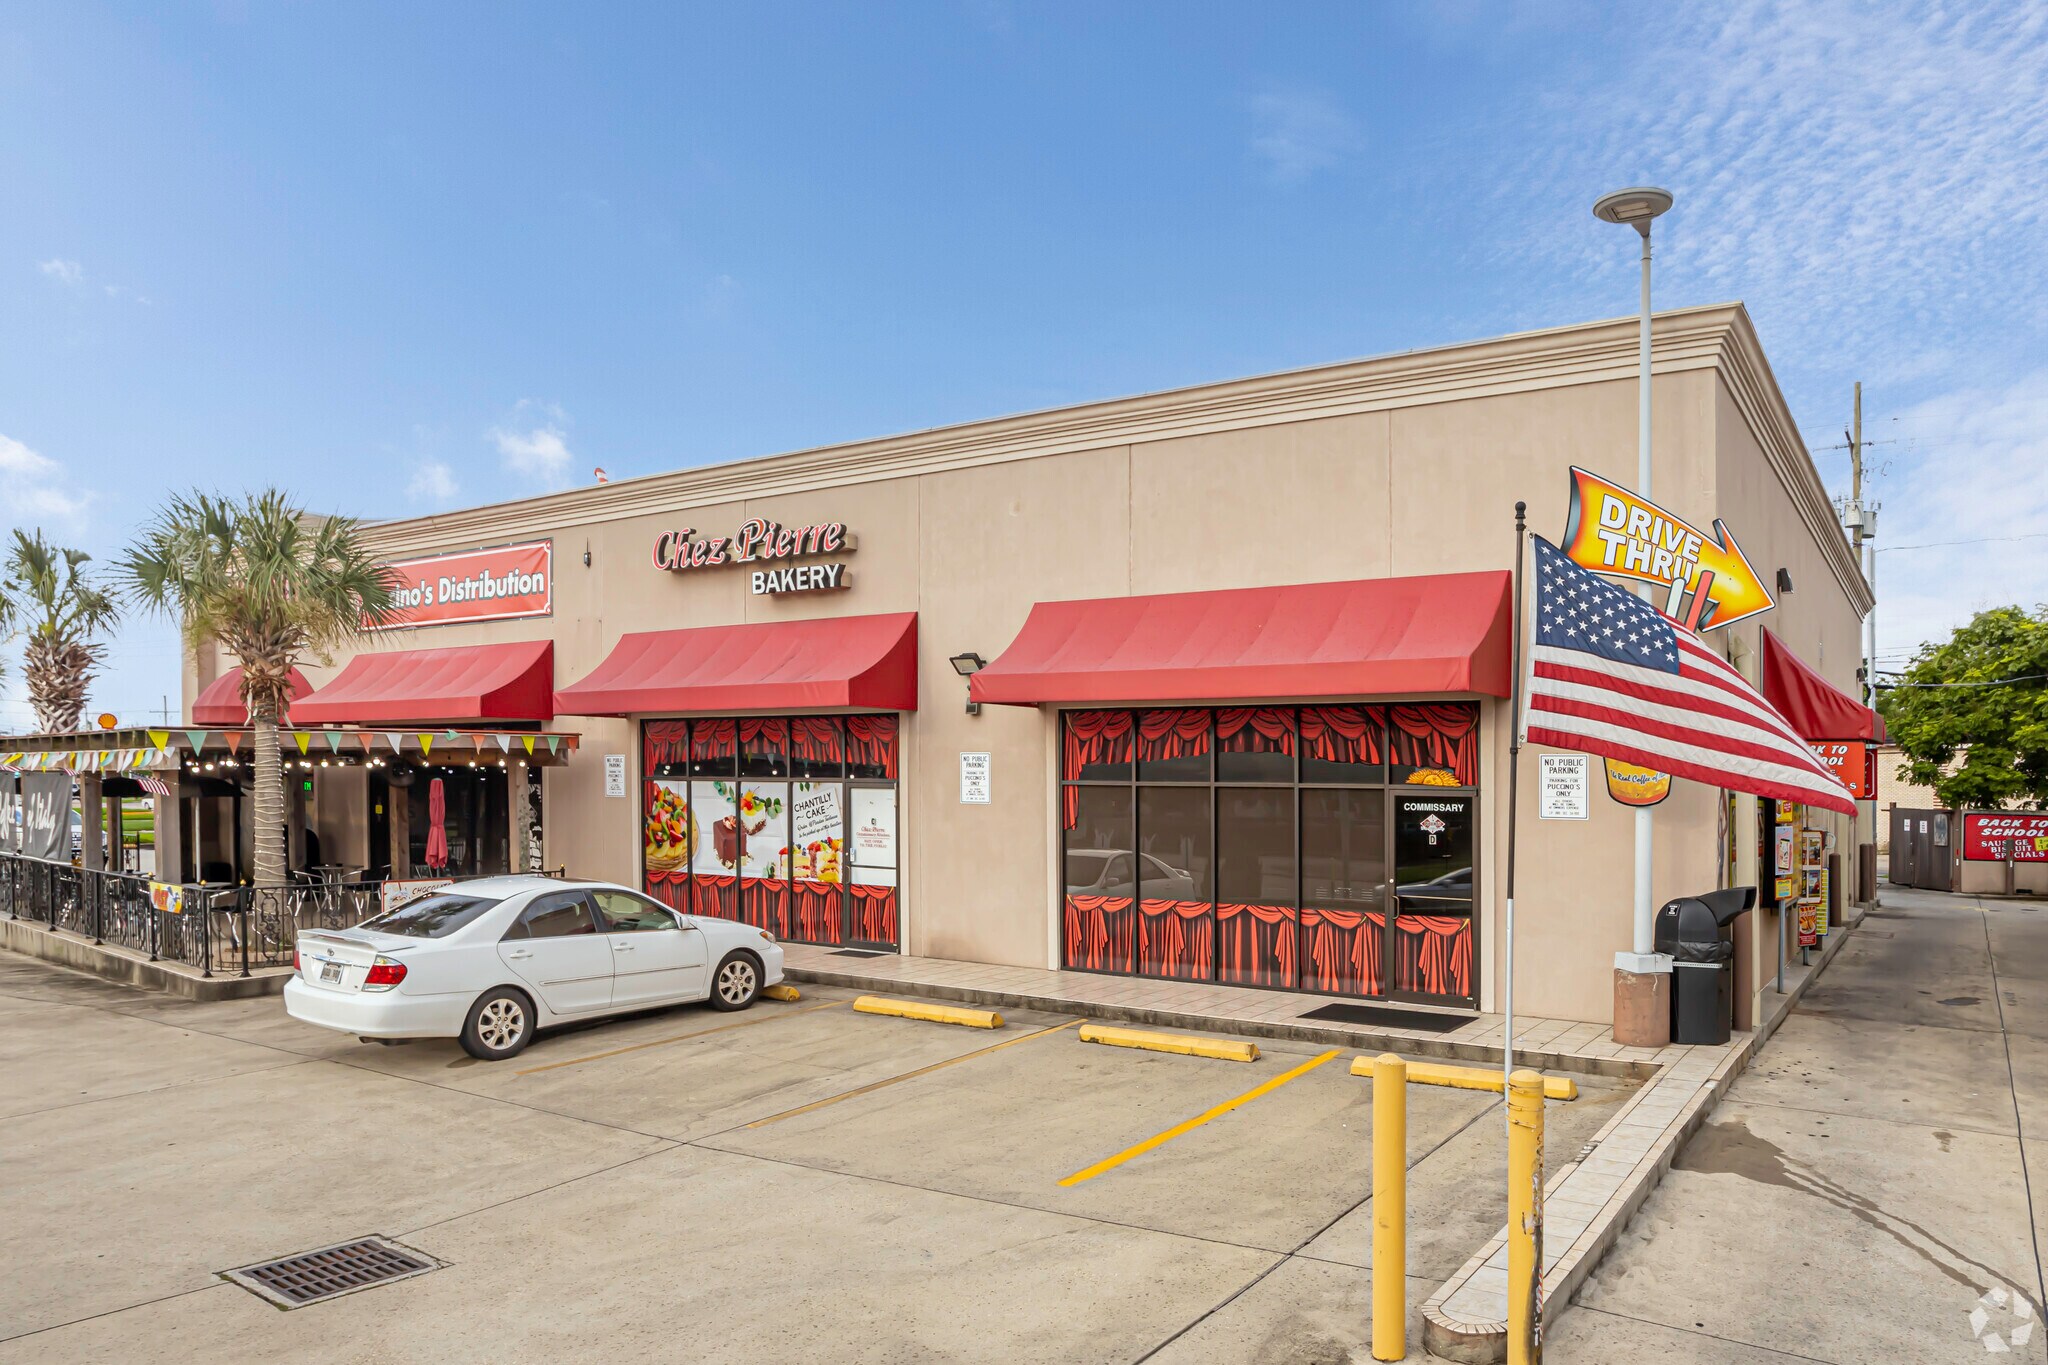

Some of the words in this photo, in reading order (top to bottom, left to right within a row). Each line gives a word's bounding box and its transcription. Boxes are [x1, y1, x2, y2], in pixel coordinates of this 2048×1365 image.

[1600, 494, 1703, 563] DRIVE
[652, 527, 727, 570] Chez
[734, 517, 842, 563] Pierre
[1598, 529, 1694, 585] THRU
[752, 564, 840, 594] BAKERY
[438, 568, 545, 605] Distribution
[1832, 745, 1848, 754] TO
[1632, 774, 1650, 784] Coffee
[794, 792, 832, 812] CHANTILLY
[1404, 802, 1464, 812] COMMISSARY
[806, 805, 826, 819] CAKE
[1978, 818, 2023, 827] BACK
[2030, 820, 2048, 828] TO
[1981, 828, 2045, 837] SCHOOL
[1995, 851, 2045, 859] SPCIALS
